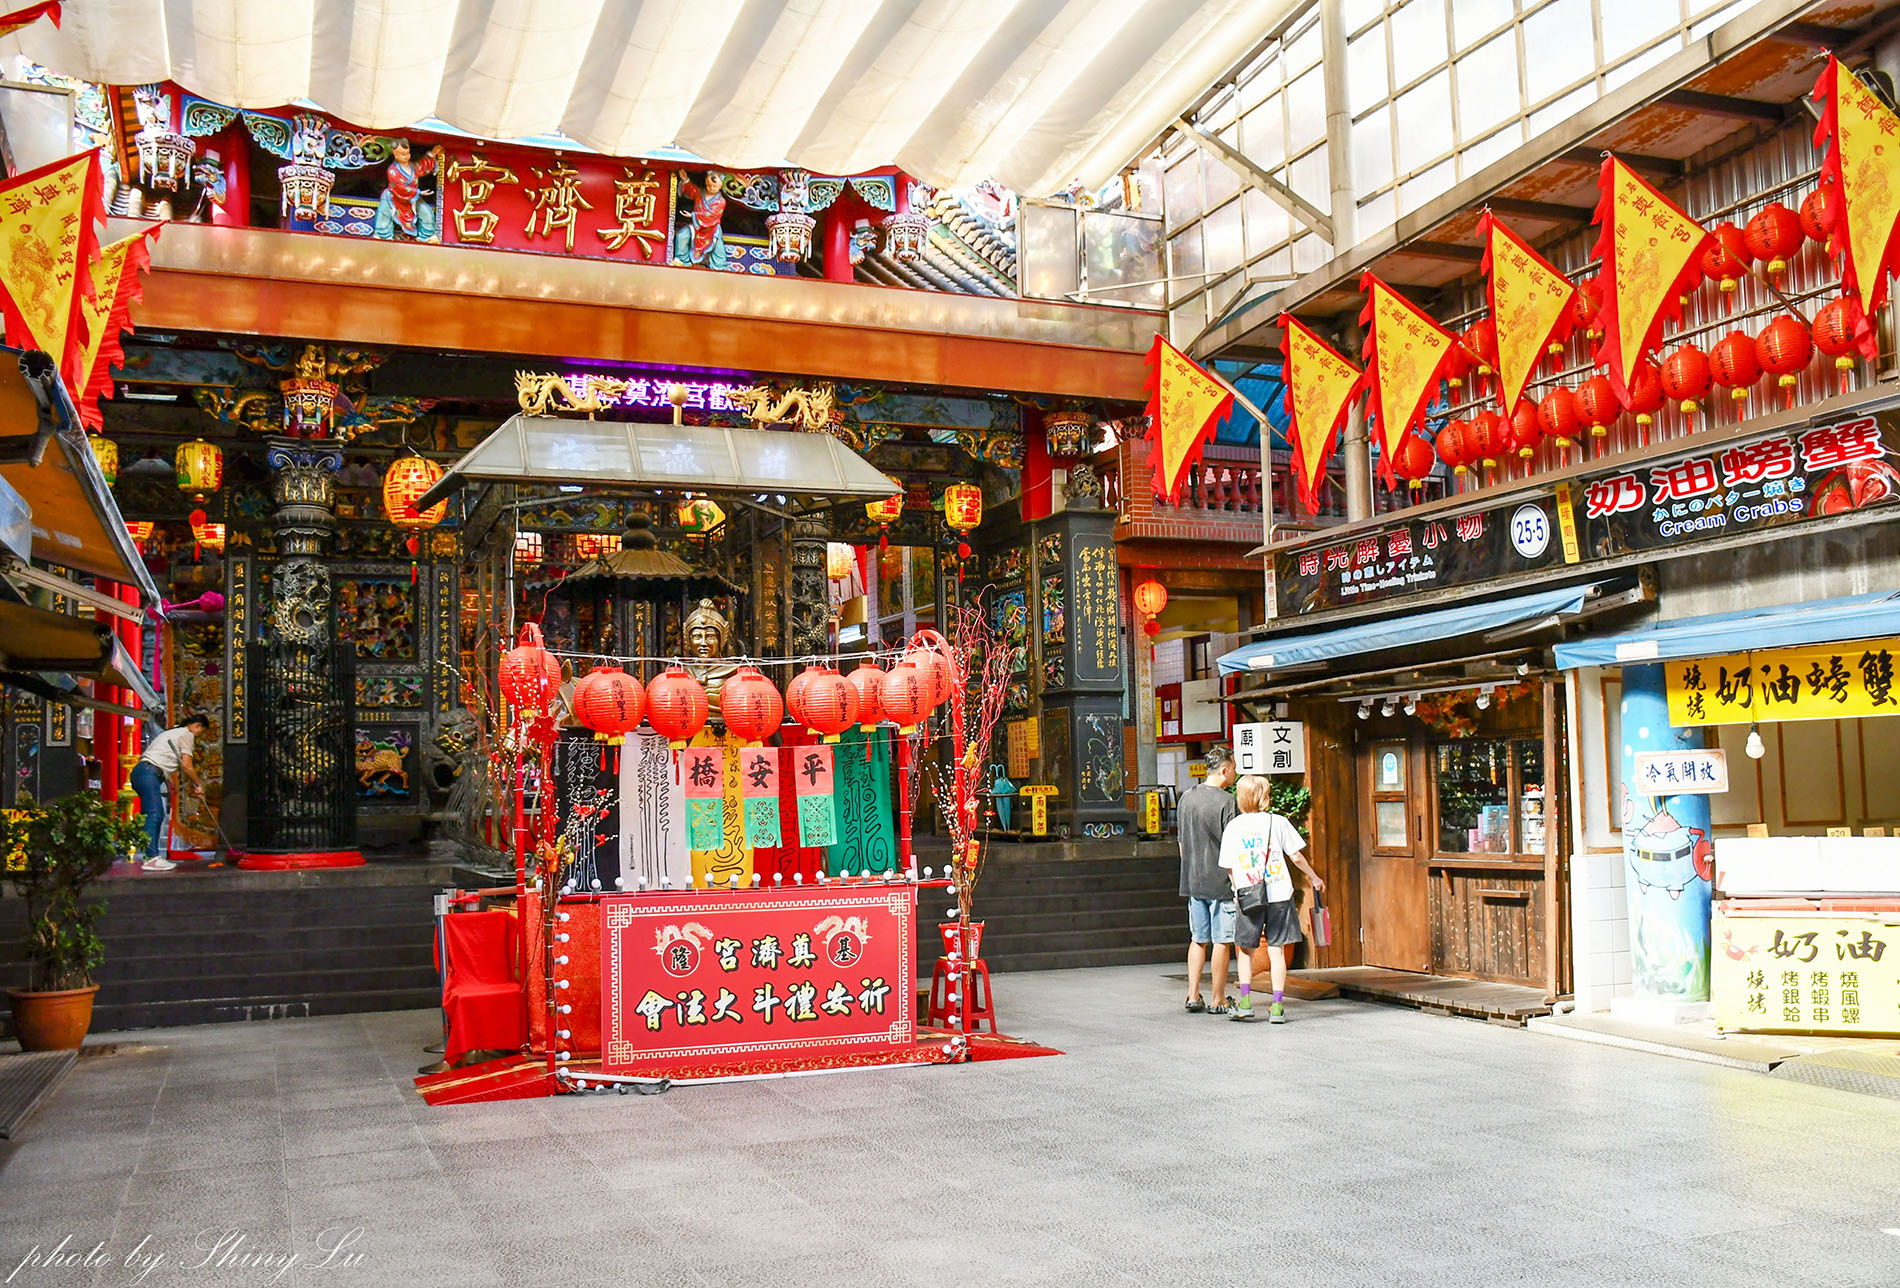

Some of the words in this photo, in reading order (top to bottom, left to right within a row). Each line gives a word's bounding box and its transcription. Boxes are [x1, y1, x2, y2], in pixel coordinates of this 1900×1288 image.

[447, 155, 666, 259] 奠濟宮
[1586, 416, 1884, 518] 奶油螃蟹
[1654, 477, 1806, 521] かにのバター焼き
[1660, 513, 1726, 537] Cream
[1734, 498, 1803, 521] Crabs
[1300, 514, 1484, 577] 時光解憂小物
[1683, 664, 1707, 720] 燒烤
[1715, 649, 1898, 710] 奶油螃蟹
[1241, 729, 1253, 769] 廟口
[1273, 726, 1291, 768] 文創
[690, 756, 719, 787] 橋
[748, 755, 774, 788] 安
[802, 754, 826, 786] 平
[1645, 761, 1716, 783] 冷氣開放
[671, 946, 691, 970] 隆
[834, 937, 857, 961] 基
[1767, 929, 1888, 963] 奶油
[634, 978, 893, 1033] 祈安禮斗大法會
[1747, 969, 1769, 1015] 燒烤
[1781, 970, 1801, 1023] 烤銀蛤
[1810, 970, 1830, 1024] 烤蝦串
[1840, 970, 1861, 1025] 燒風螺
